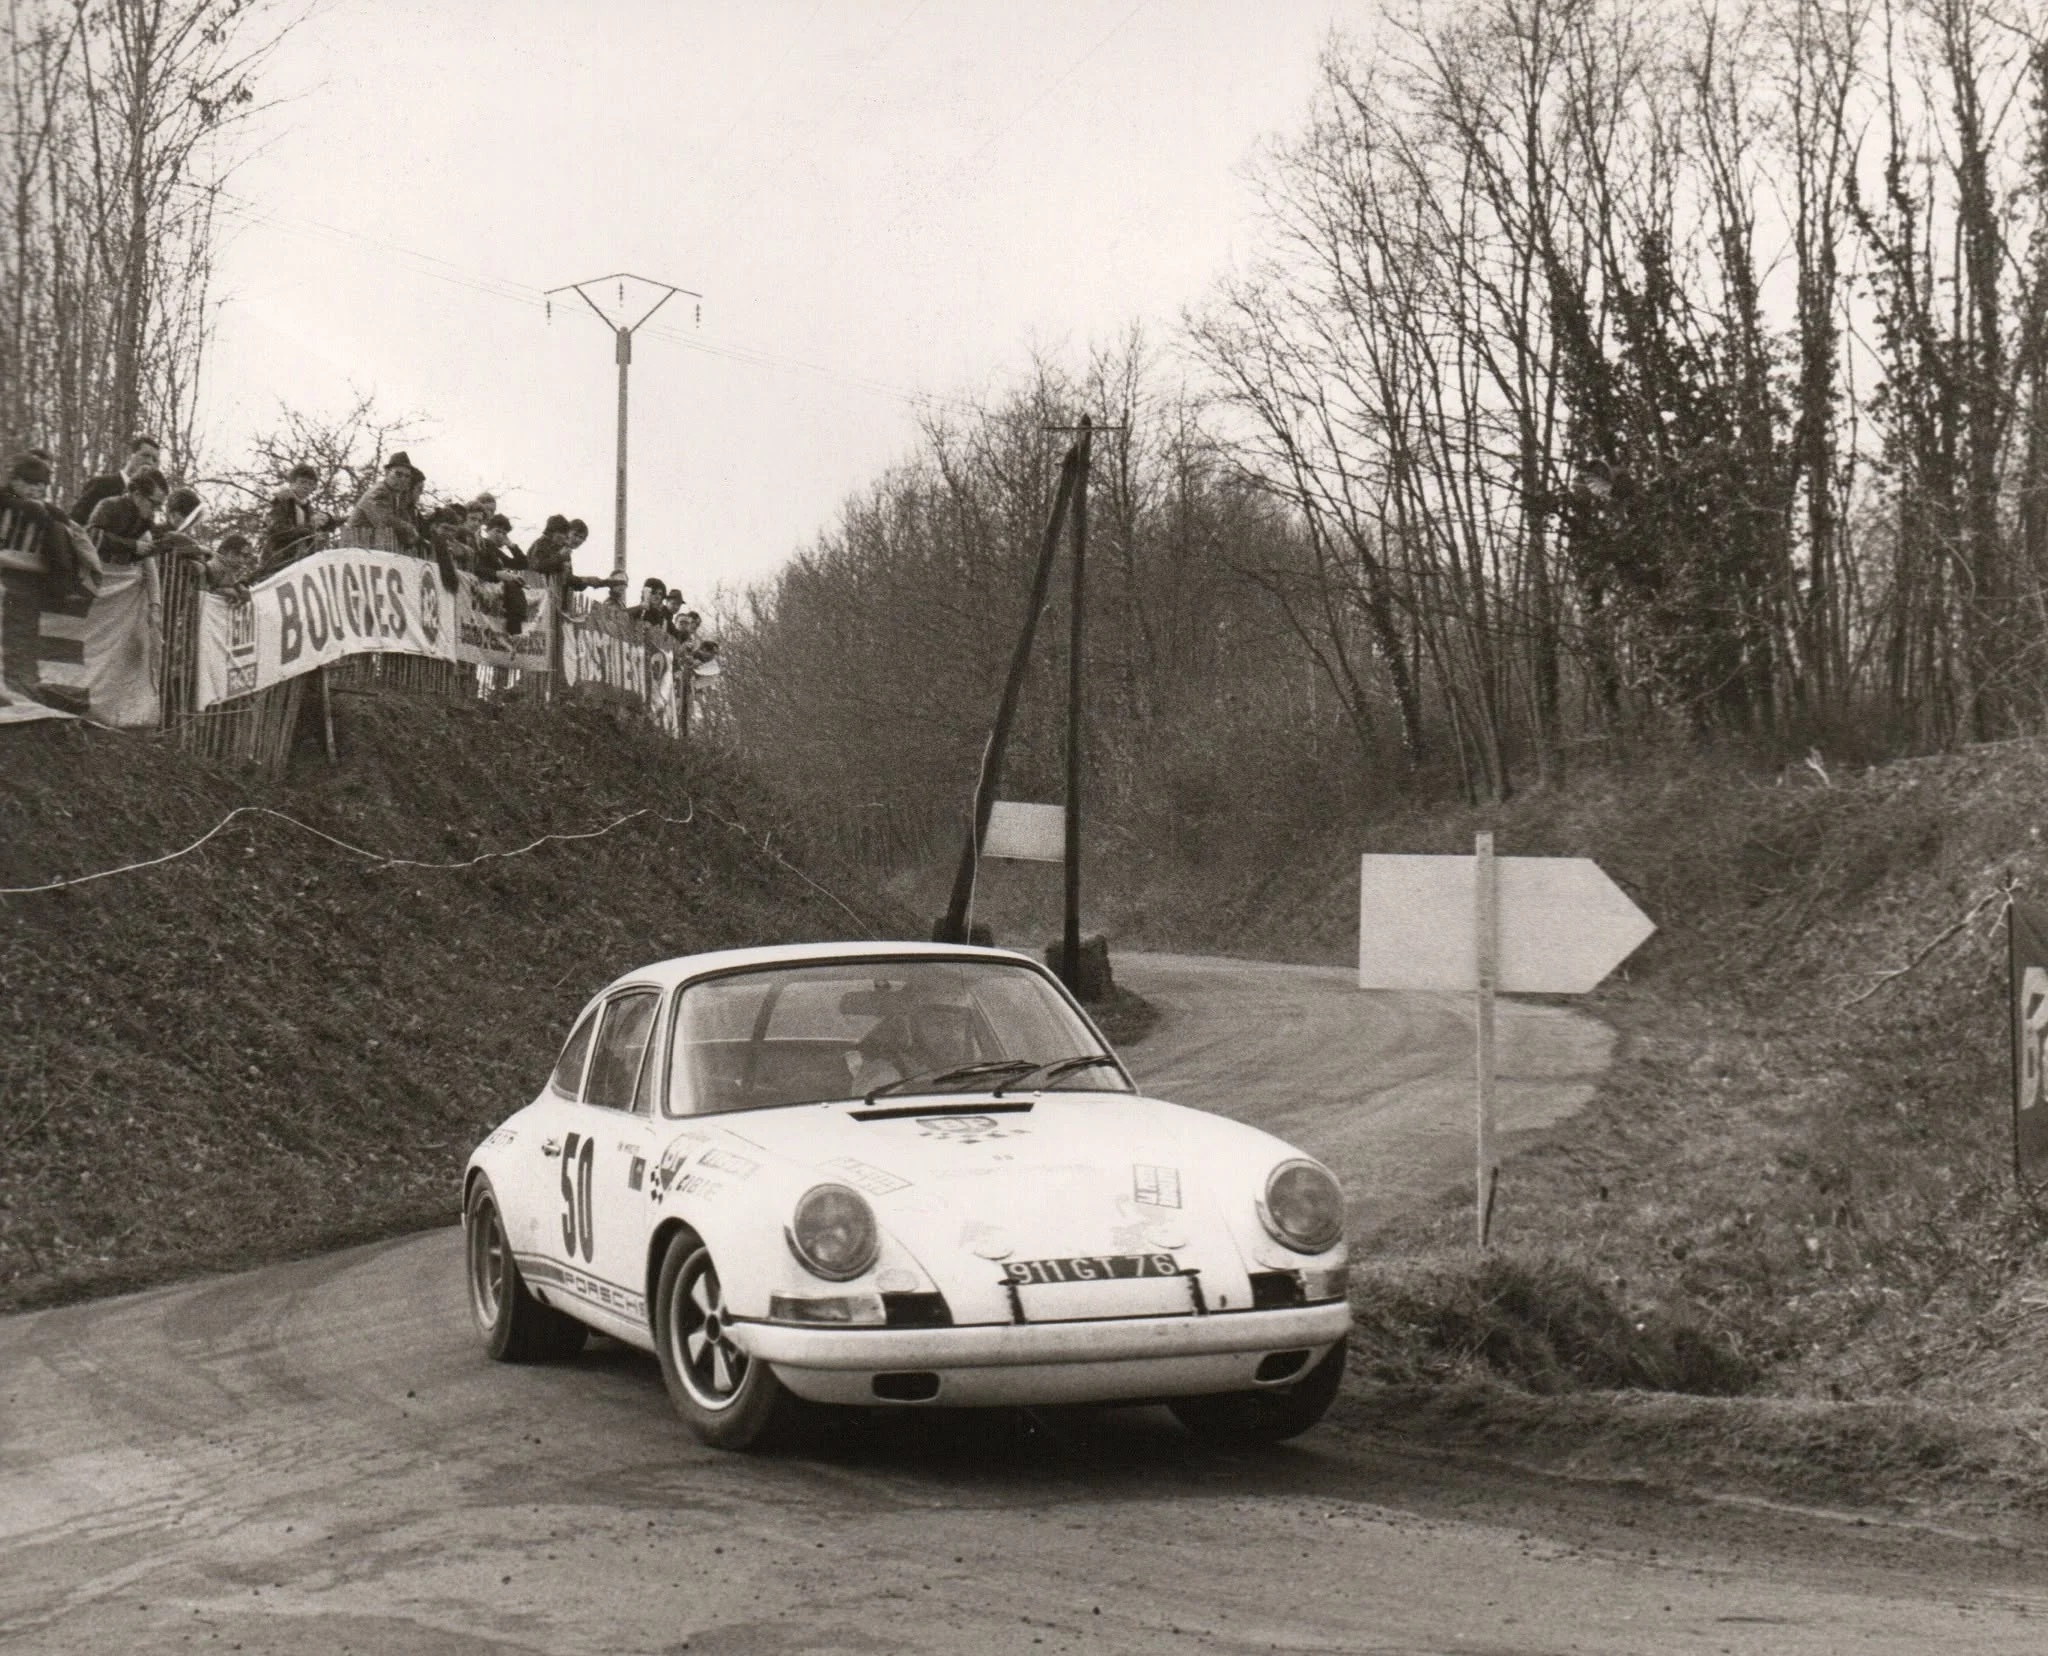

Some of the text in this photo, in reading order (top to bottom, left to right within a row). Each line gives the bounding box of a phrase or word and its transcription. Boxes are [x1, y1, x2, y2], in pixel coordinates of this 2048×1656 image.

[276, 563, 406, 666] BOUGIES
[561, 1132, 594, 1264] 50
[564, 1271, 646, 1318] PORSCHE
[1009, 1254, 1175, 1284] 911 GT 76
